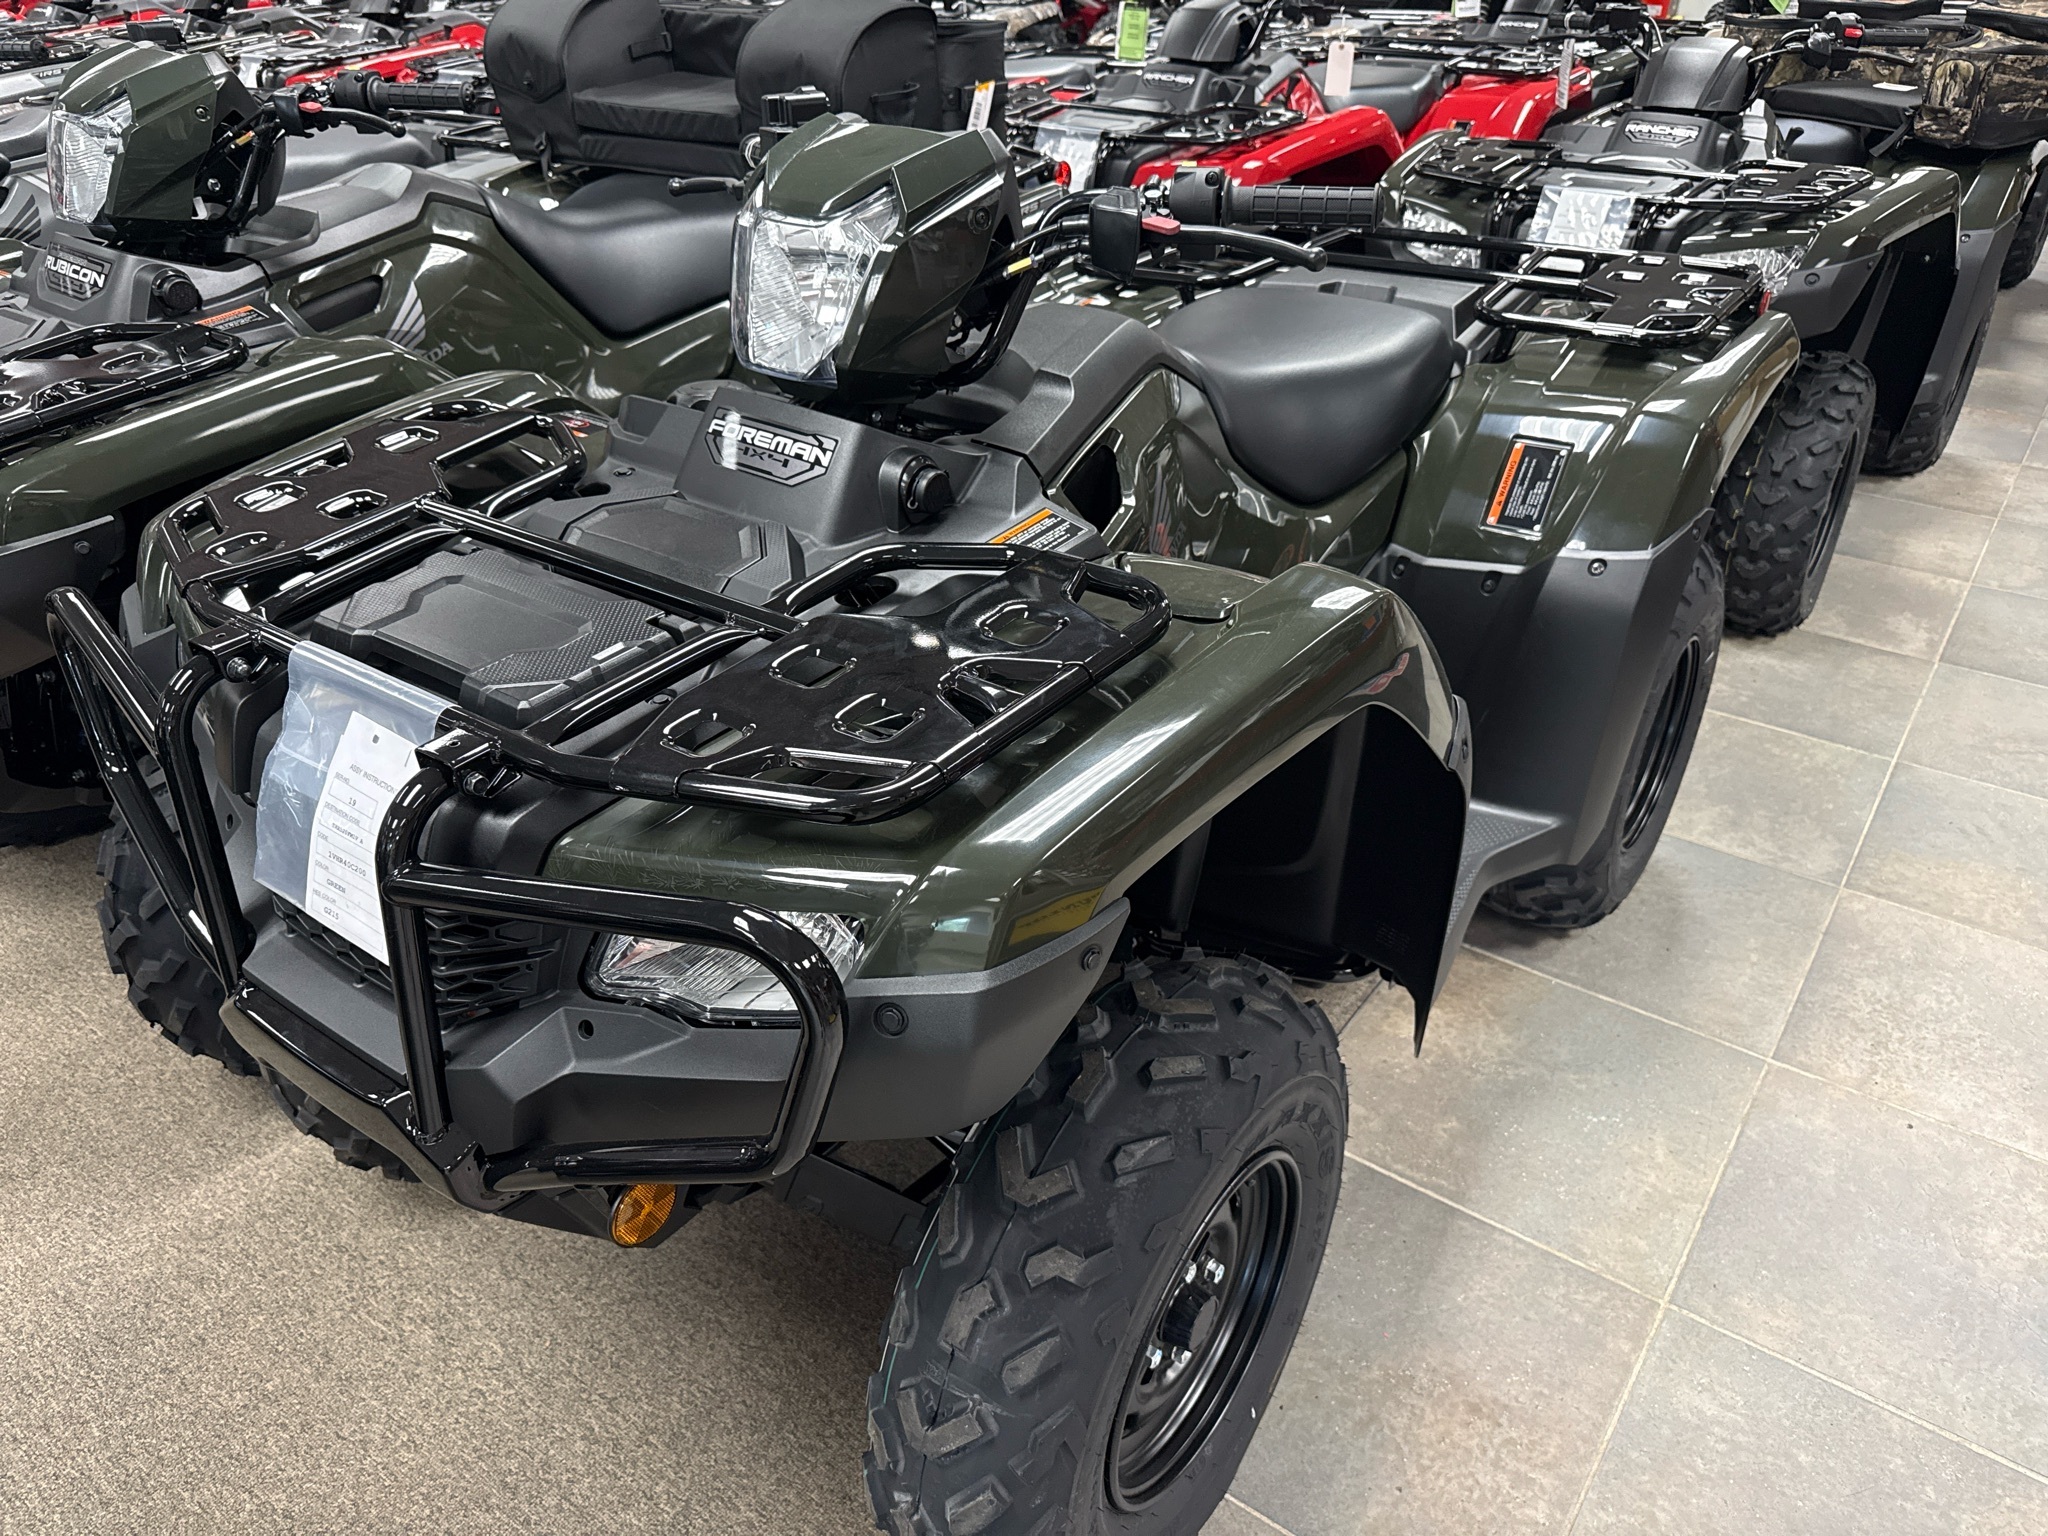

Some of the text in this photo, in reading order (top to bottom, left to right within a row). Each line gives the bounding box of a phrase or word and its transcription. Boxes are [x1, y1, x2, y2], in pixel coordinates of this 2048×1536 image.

[1143, 72, 1196, 85] RANCHER
[1625, 124, 1699, 138] RANCHER
[45, 255, 106, 288] RUBICON
[708, 419, 833, 467] FOREMAN
[1500, 460, 1517, 497] WARNING
[348, 763, 363, 775] ASSY
[348, 797, 357, 807] 19
[314, 859, 330, 871] COLOR
[326, 878, 346, 894] GREEN
